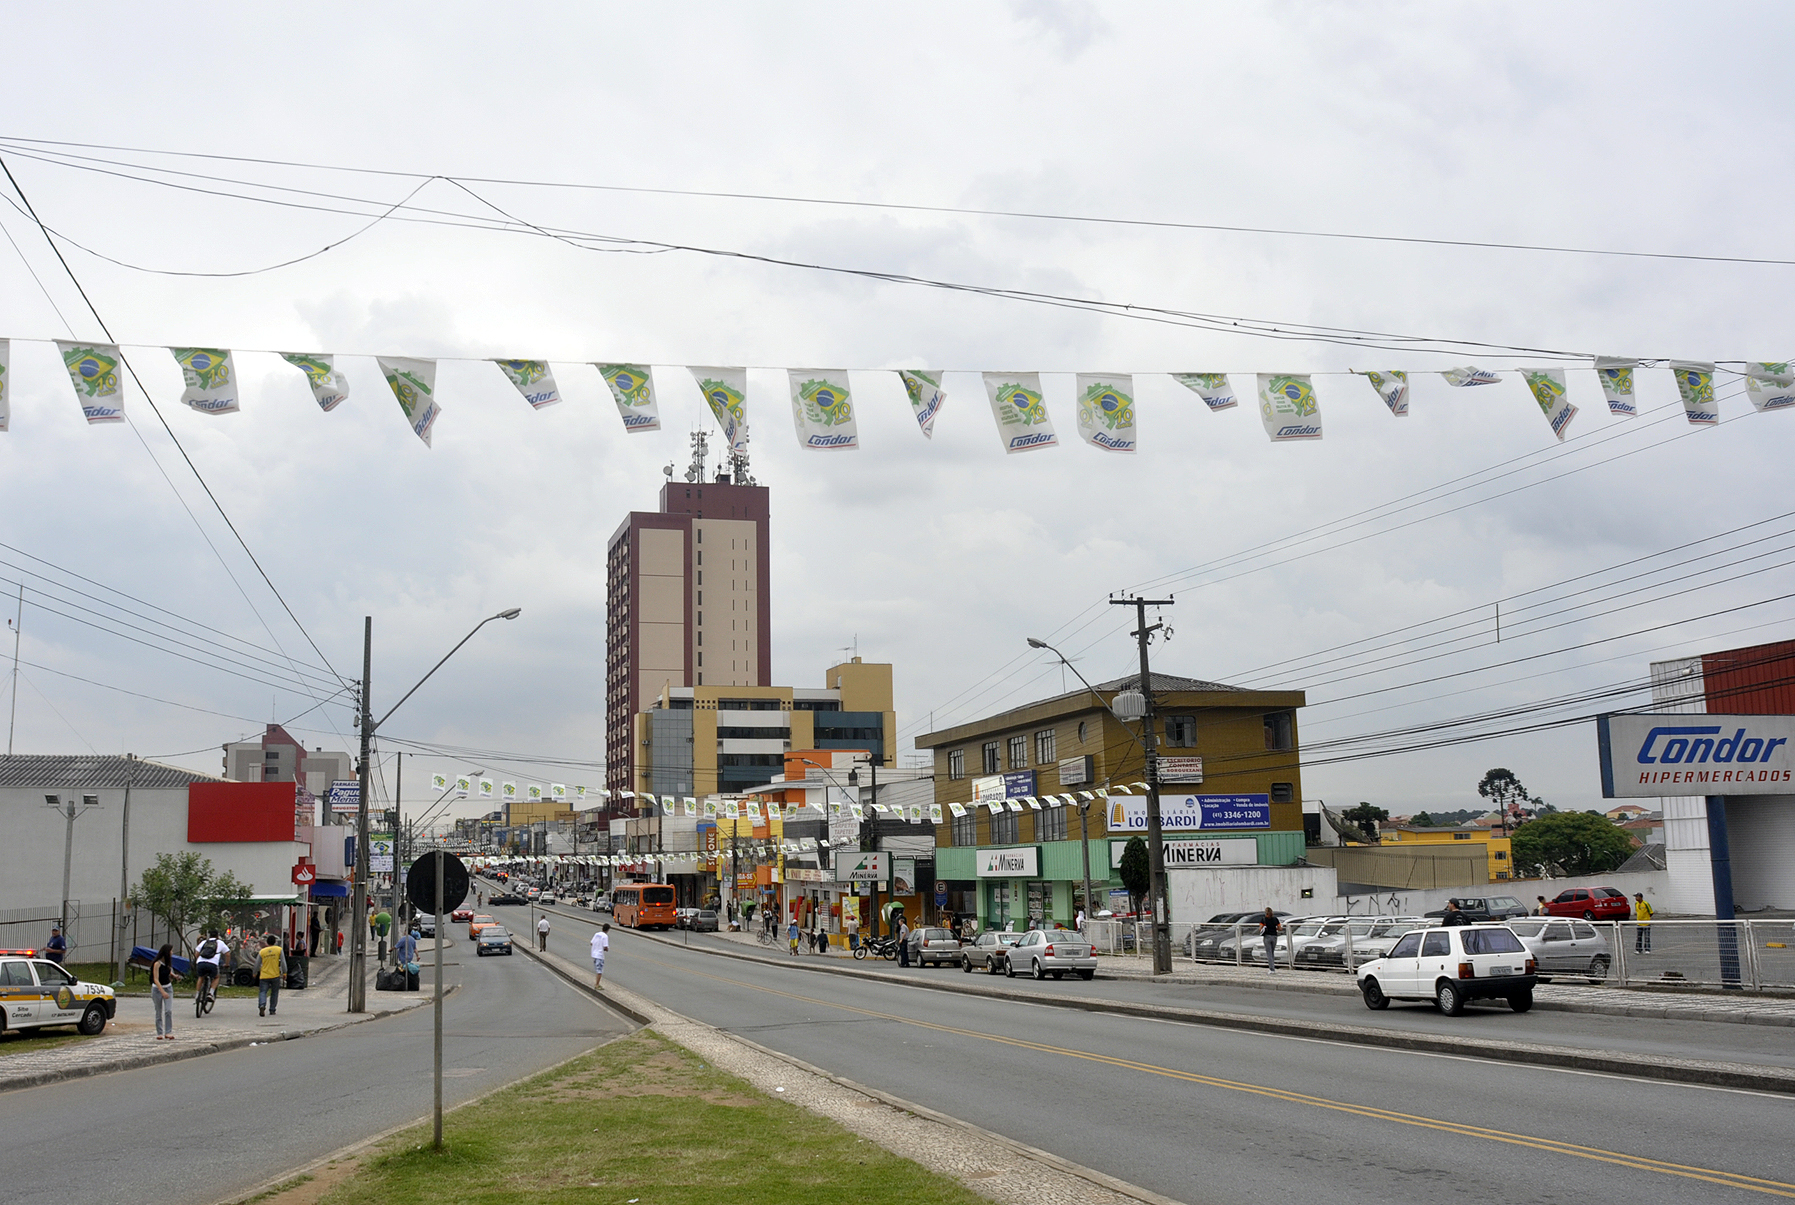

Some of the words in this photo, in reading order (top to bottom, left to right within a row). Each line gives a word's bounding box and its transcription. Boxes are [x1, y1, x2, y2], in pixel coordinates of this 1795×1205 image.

[1618, 378, 1632, 391] 10
[630, 387, 651, 401] 10
[1699, 385, 1714, 399] 10
[1300, 395, 1316, 411] 10
[832, 402, 851, 420] 10
[1029, 404, 1046, 419] 10
[1114, 408, 1134, 424] 10
[1276, 425, 1321, 436] Condor
[807, 434, 857, 445] Condor
[1009, 432, 1055, 448] Condor
[1637, 725, 1788, 765] Condor
[1638, 770, 1792, 784] HIPERMERCADOS
[1128, 816, 1197, 828] LOBARDI
[707, 832, 716, 866] SIONE
[998, 853, 1025, 871] MINERVA
[849, 871, 878, 879] MINERVA
[84, 984, 106, 994] 7534
